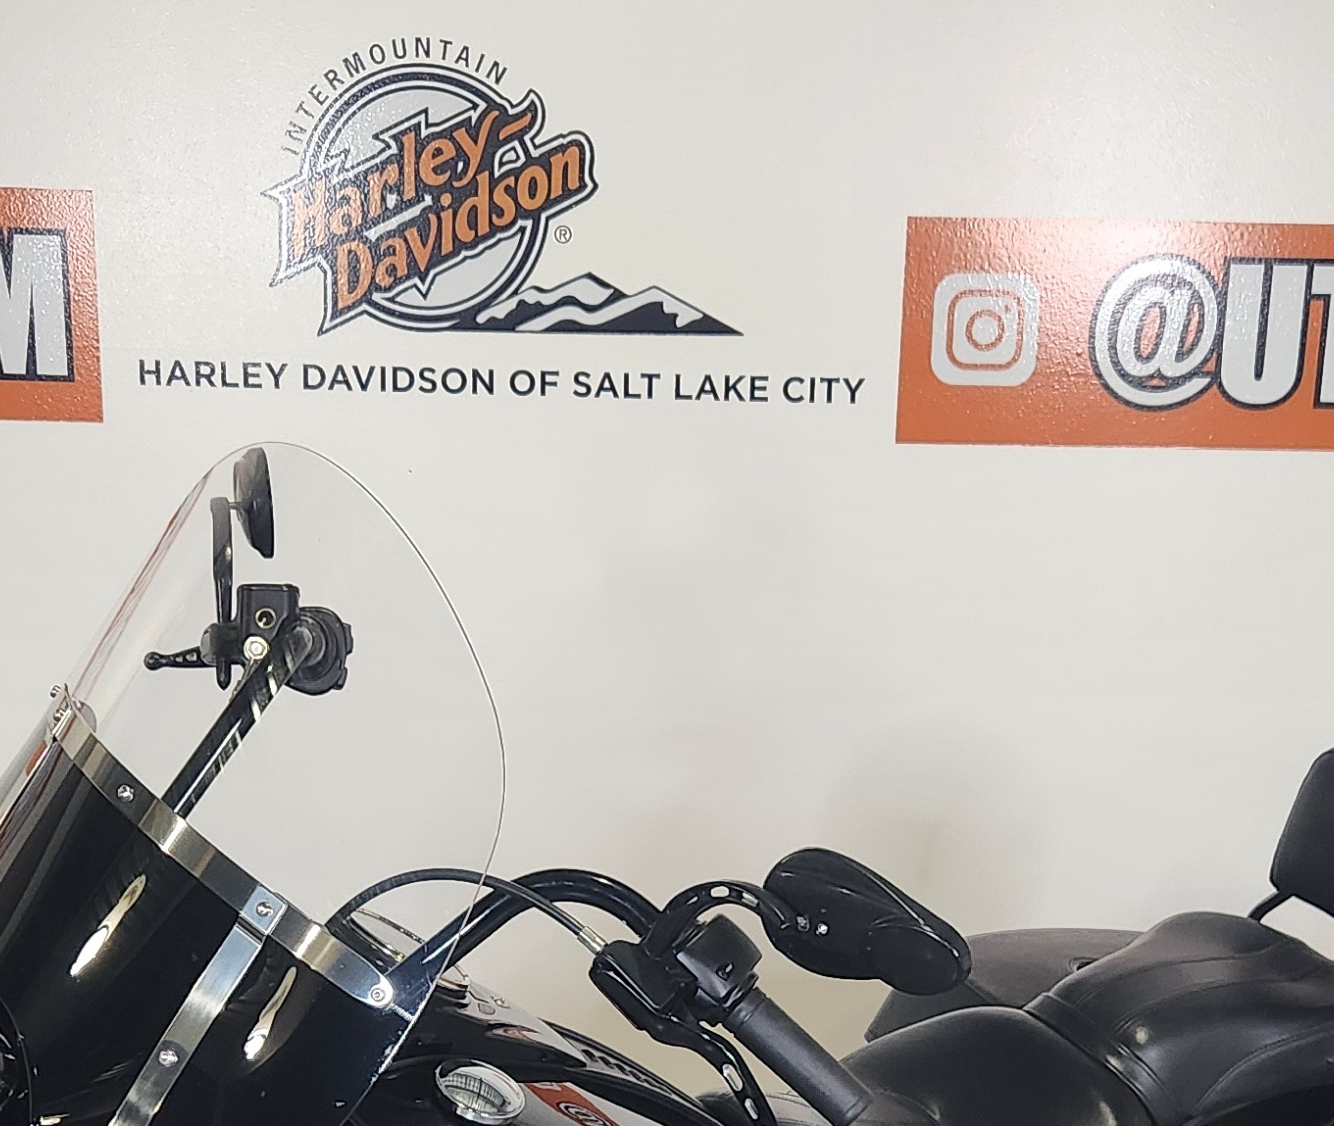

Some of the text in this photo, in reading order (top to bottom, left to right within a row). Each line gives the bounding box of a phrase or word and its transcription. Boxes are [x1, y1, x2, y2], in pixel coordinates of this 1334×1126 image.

[281, 37, 507, 156] INTERMOUNTAIN
[337, 146, 581, 310] Davidson
[138, 359, 866, 404] HARLEY DAVIDSON OF SALT LAKE CITY
